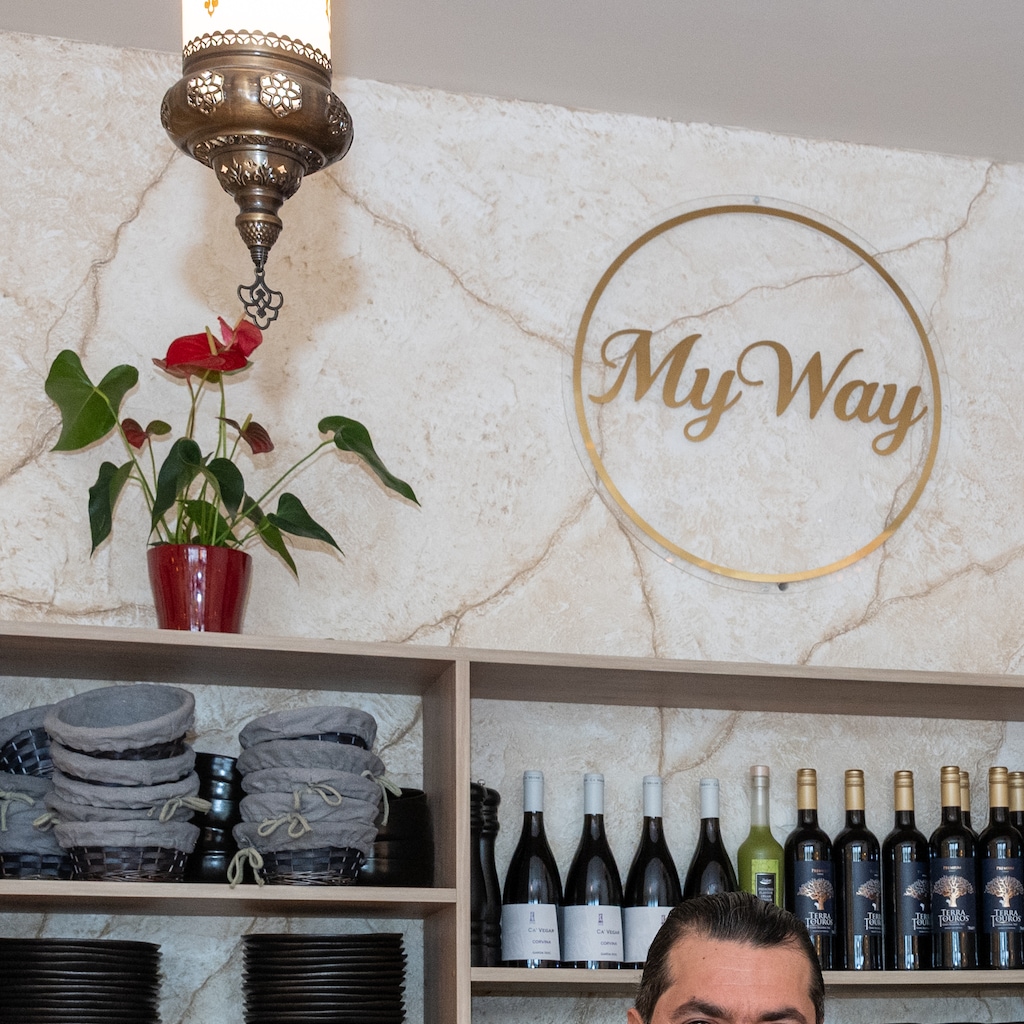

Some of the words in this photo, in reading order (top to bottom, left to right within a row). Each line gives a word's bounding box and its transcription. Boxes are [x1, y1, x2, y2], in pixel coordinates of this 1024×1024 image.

[588, 329, 742, 442] My
[737, 340, 927, 456] Way
[808, 911, 831, 920] TERRA
[938, 915, 970, 928] TOUROS
[990, 915, 1021, 928] TOUROS
